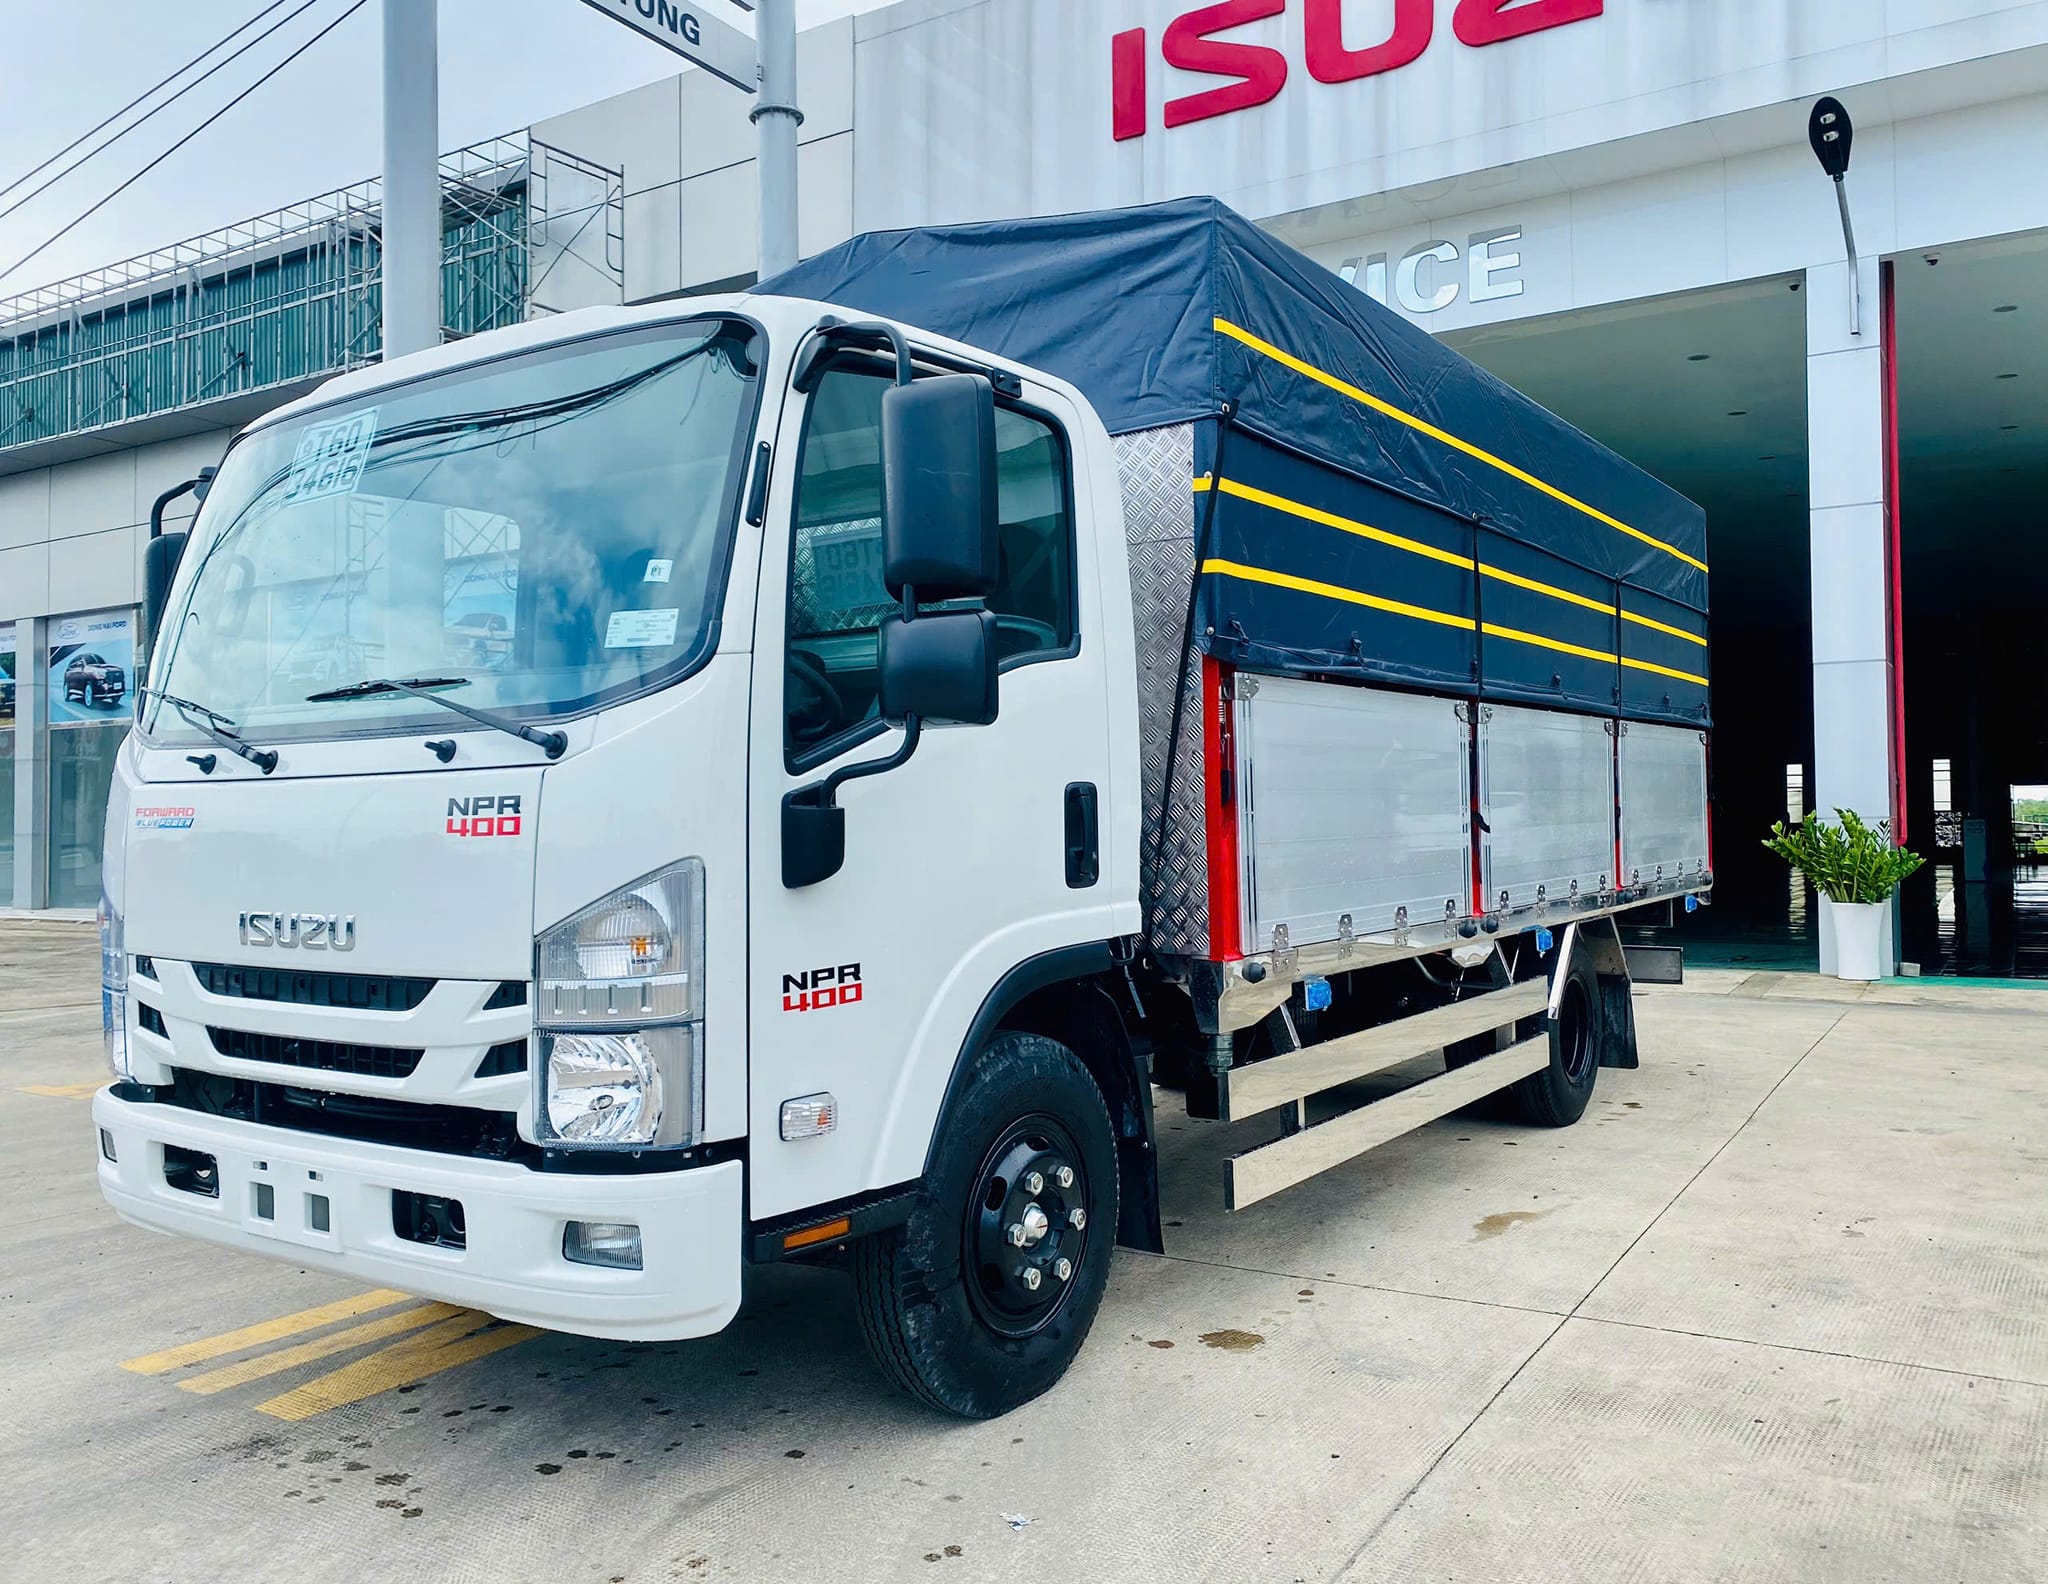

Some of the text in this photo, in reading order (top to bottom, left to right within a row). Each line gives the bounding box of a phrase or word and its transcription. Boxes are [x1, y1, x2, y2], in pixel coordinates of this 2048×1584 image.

[619, 0, 700, 46] UNG
[135, 807, 195, 817] FORWARD
[447, 795, 521, 816] NPR
[446, 816, 521, 837] 400
[239, 910, 356, 952] ISUZU
[782, 962, 862, 994] NPR
[782, 982, 862, 1012] 400
